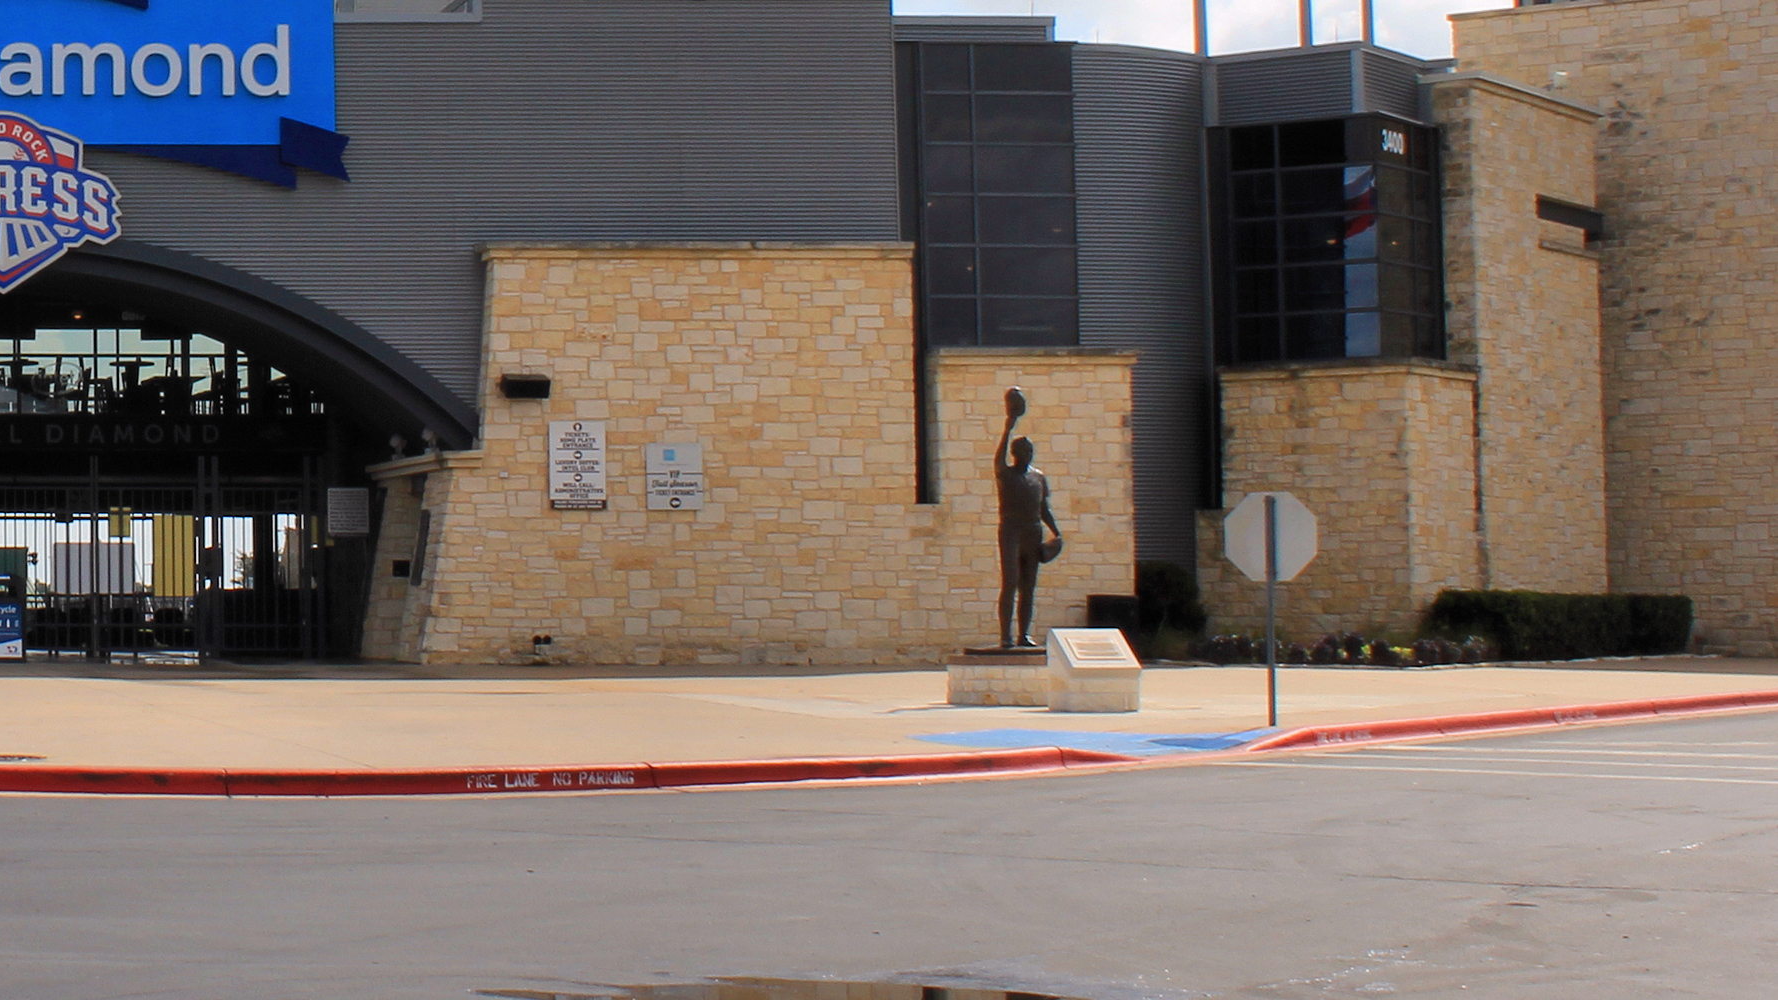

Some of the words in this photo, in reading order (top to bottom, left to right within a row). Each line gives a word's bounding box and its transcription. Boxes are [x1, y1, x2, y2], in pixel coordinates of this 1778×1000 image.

[11, 124, 49, 161] ROCK
[1382, 128, 1405, 155] 3400
[45, 423, 221, 444] DIAMOND
[467, 773, 498, 789] FIRE
[504, 772, 540, 788] LANE
[553, 772, 571, 786] NO
[578, 770, 634, 786] PARKING
